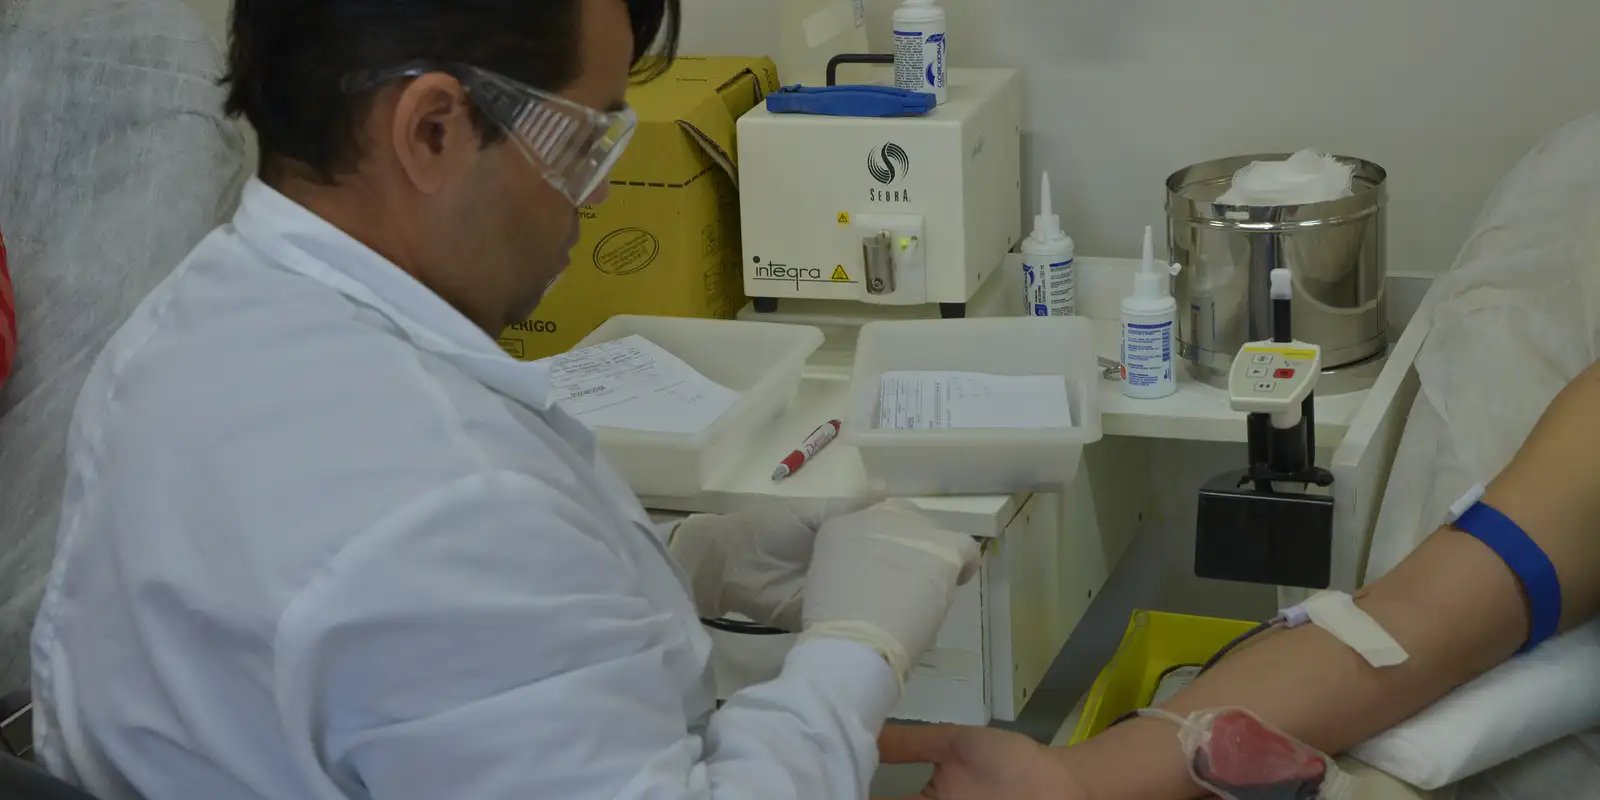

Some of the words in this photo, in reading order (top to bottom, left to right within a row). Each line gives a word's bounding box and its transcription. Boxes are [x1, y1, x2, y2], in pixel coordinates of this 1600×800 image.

[870, 188, 909, 203] SEBRA
[752, 255, 821, 291] integra
[506, 319, 557, 333] ERIGO
